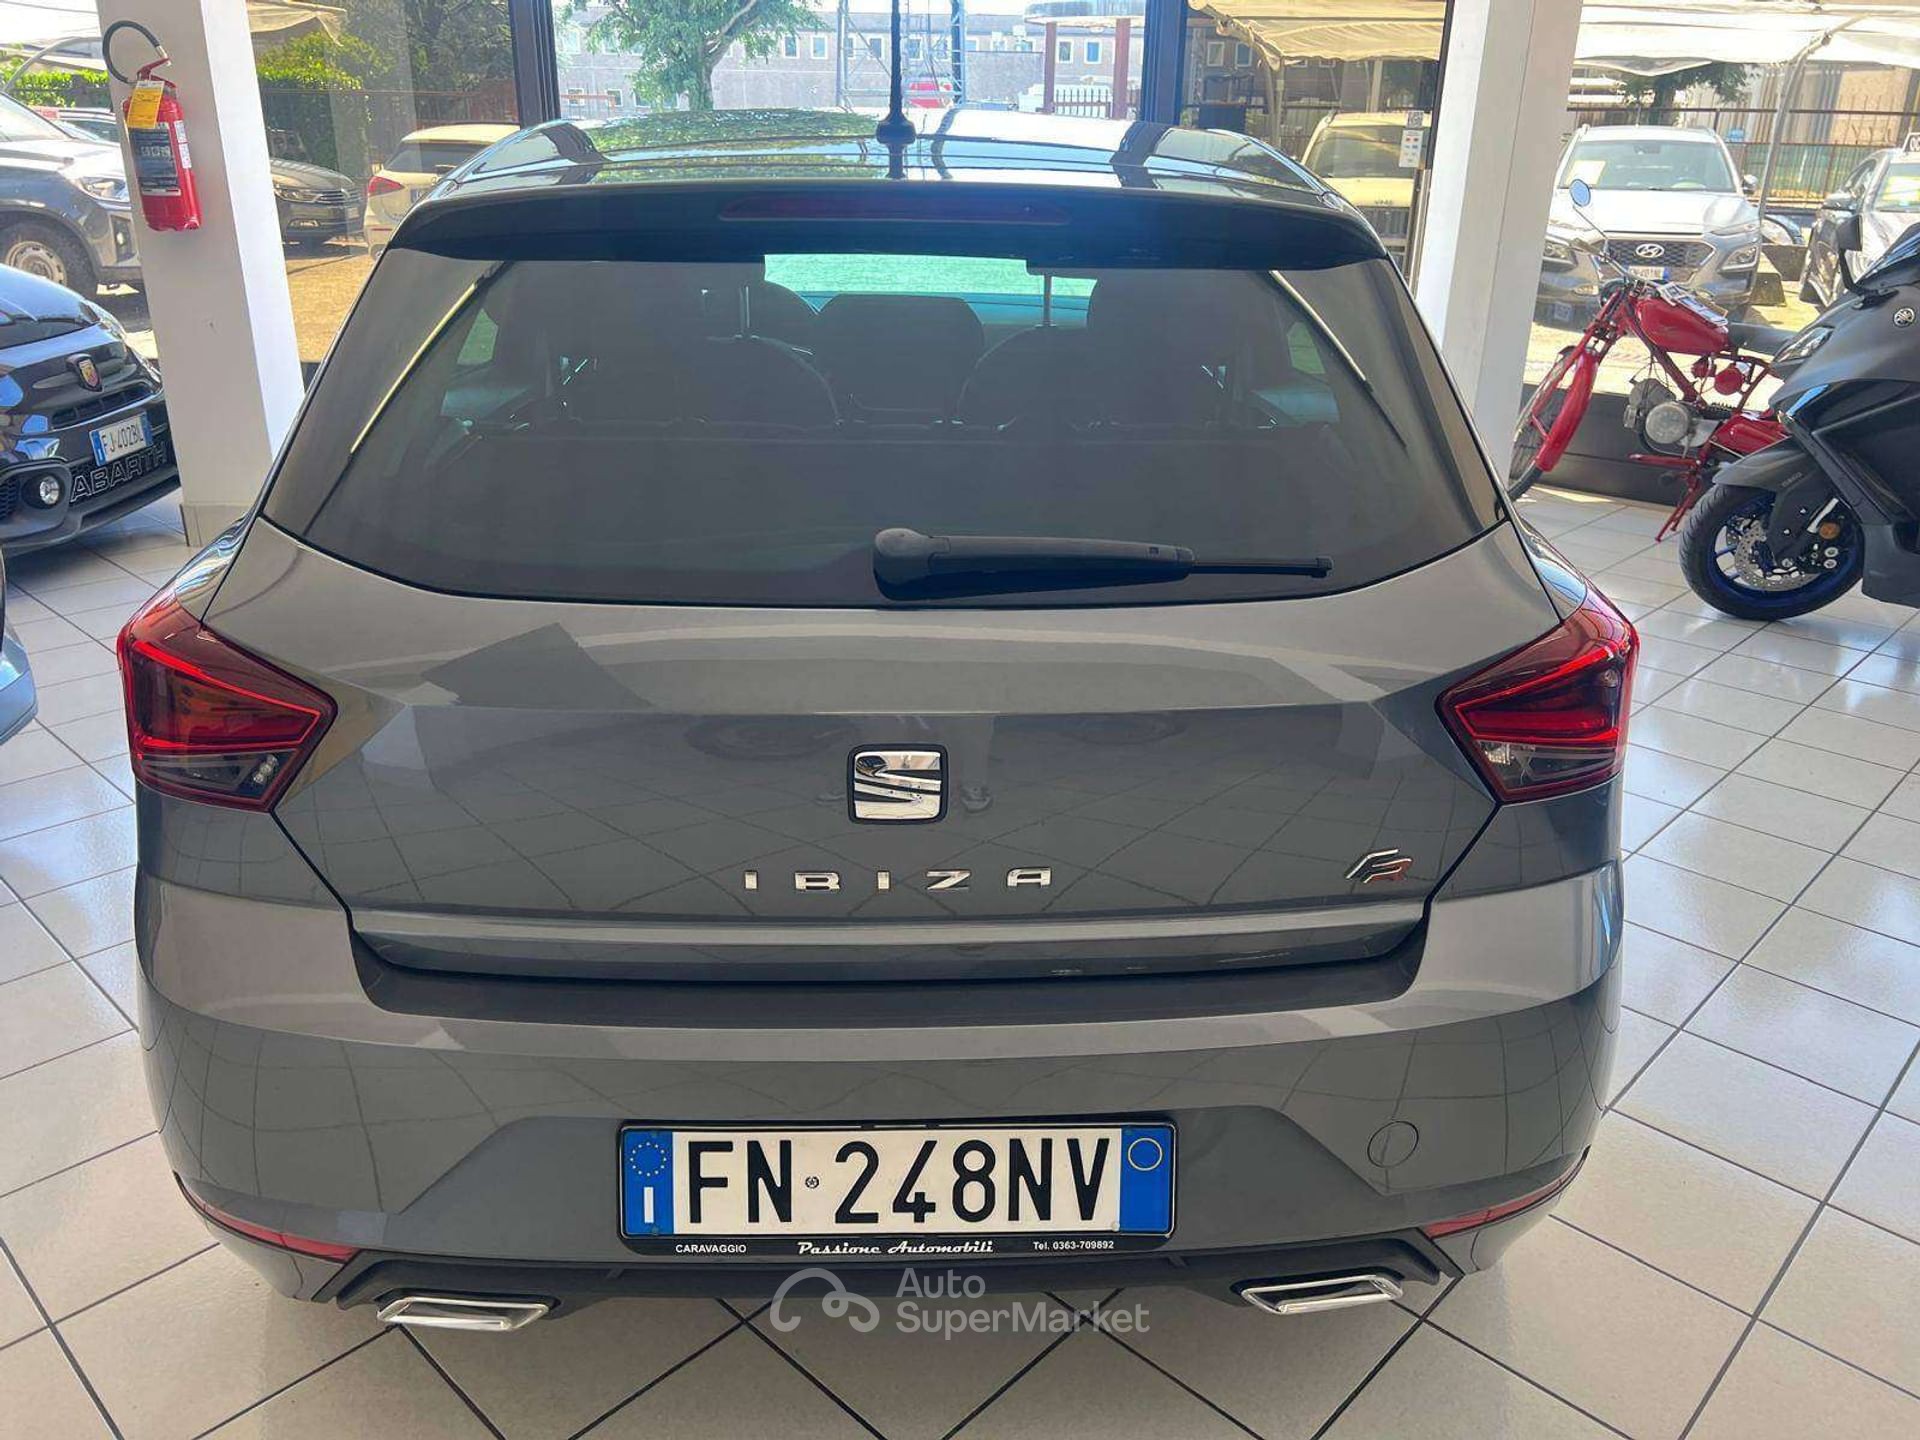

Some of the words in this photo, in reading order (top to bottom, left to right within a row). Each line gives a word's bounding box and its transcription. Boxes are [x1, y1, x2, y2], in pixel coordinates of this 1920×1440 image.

[69, 441, 168, 503] ABARTH
[744, 868, 1052, 890] IBIZA
[687, 1139, 793, 1224] FN
[834, 1138, 1110, 1224] 248NV
[675, 1244, 747, 1254] CARAVAGGIO
[797, 1241, 882, 1254] Passione
[888, 1240, 994, 1254] Automobili
[1033, 1241, 1050, 1251] Tel.
[1052, 1240, 1115, 1250] 0363-709892
